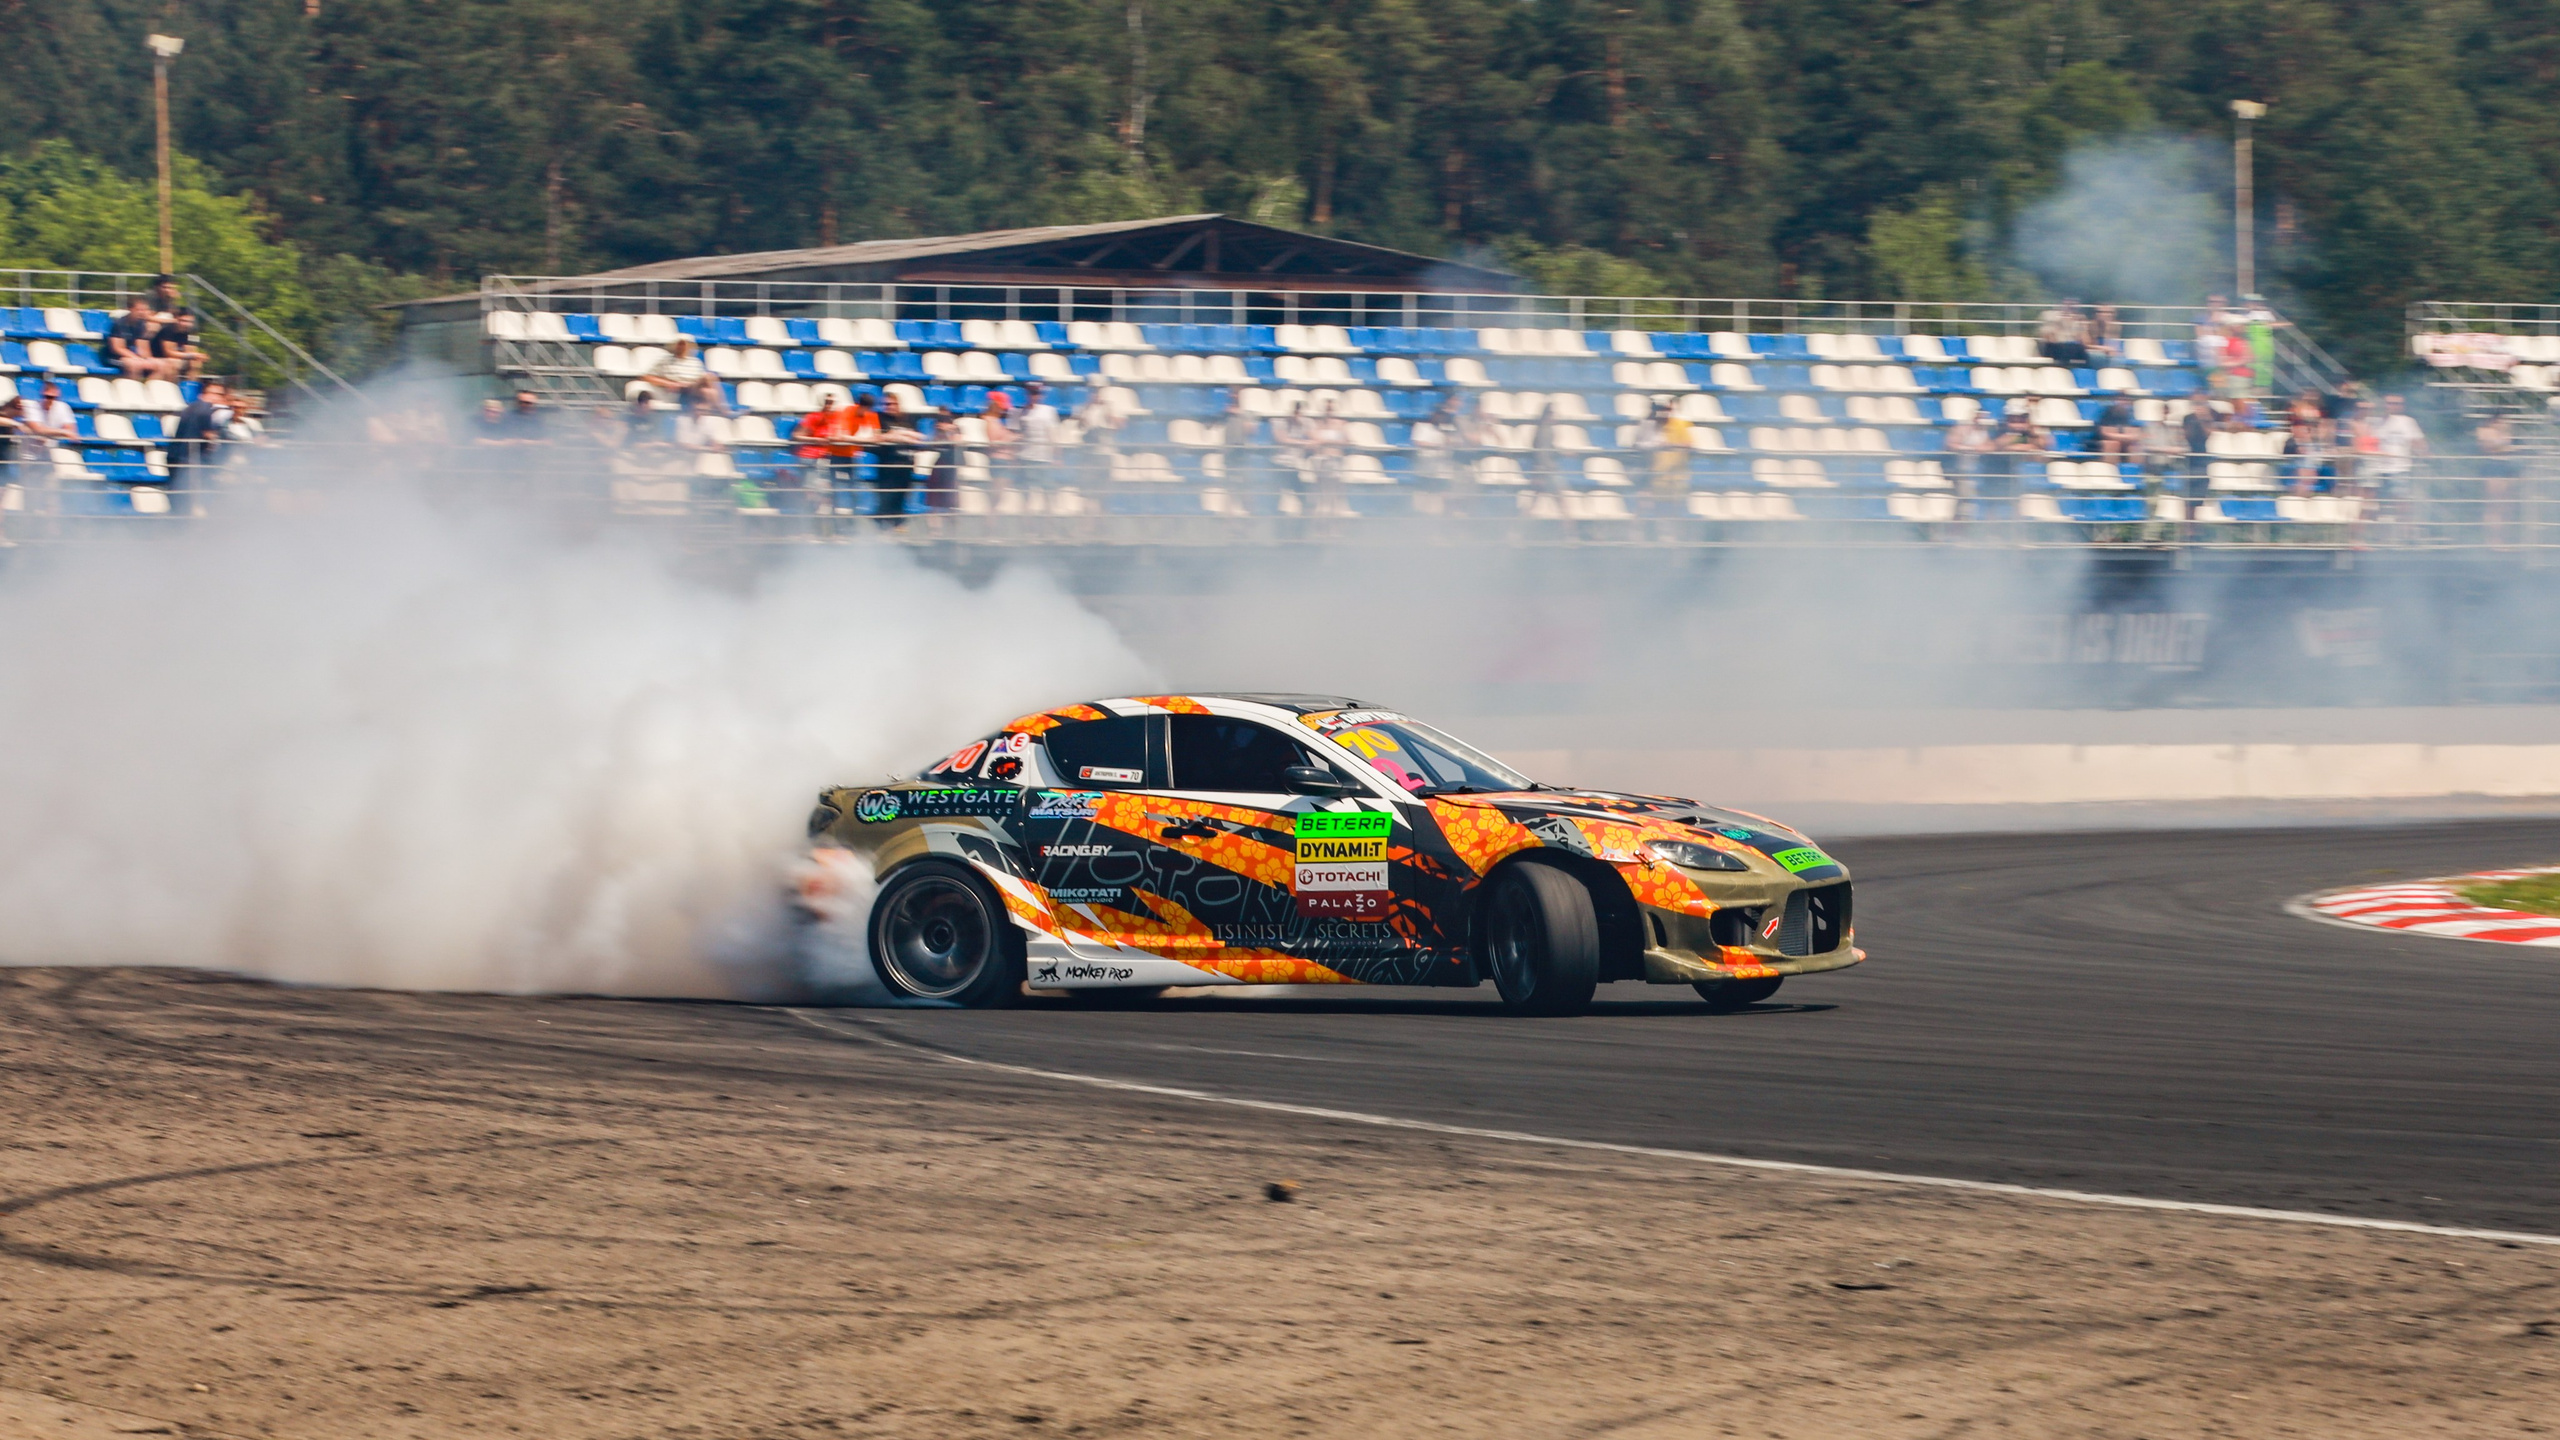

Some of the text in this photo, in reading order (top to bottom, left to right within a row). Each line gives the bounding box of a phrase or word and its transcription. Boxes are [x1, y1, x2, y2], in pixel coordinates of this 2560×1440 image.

[1014, 736, 1025, 748] E
[1334, 729, 1399, 759] 70
[1370, 758, 1426, 791] 2
[907, 789, 1019, 804] WESTGATE
[902, 806, 1013, 816] AUTOSERVICE
[1029, 807, 1098, 817] MATSURI
[1040, 845, 1113, 857] RACING.BY
[1315, 871, 1380, 882] TOTACHI
[1049, 888, 1122, 898] MIKOTATI
[1318, 922, 1392, 938] SECRETS
[1065, 963, 1134, 981] MONKEY PROD
